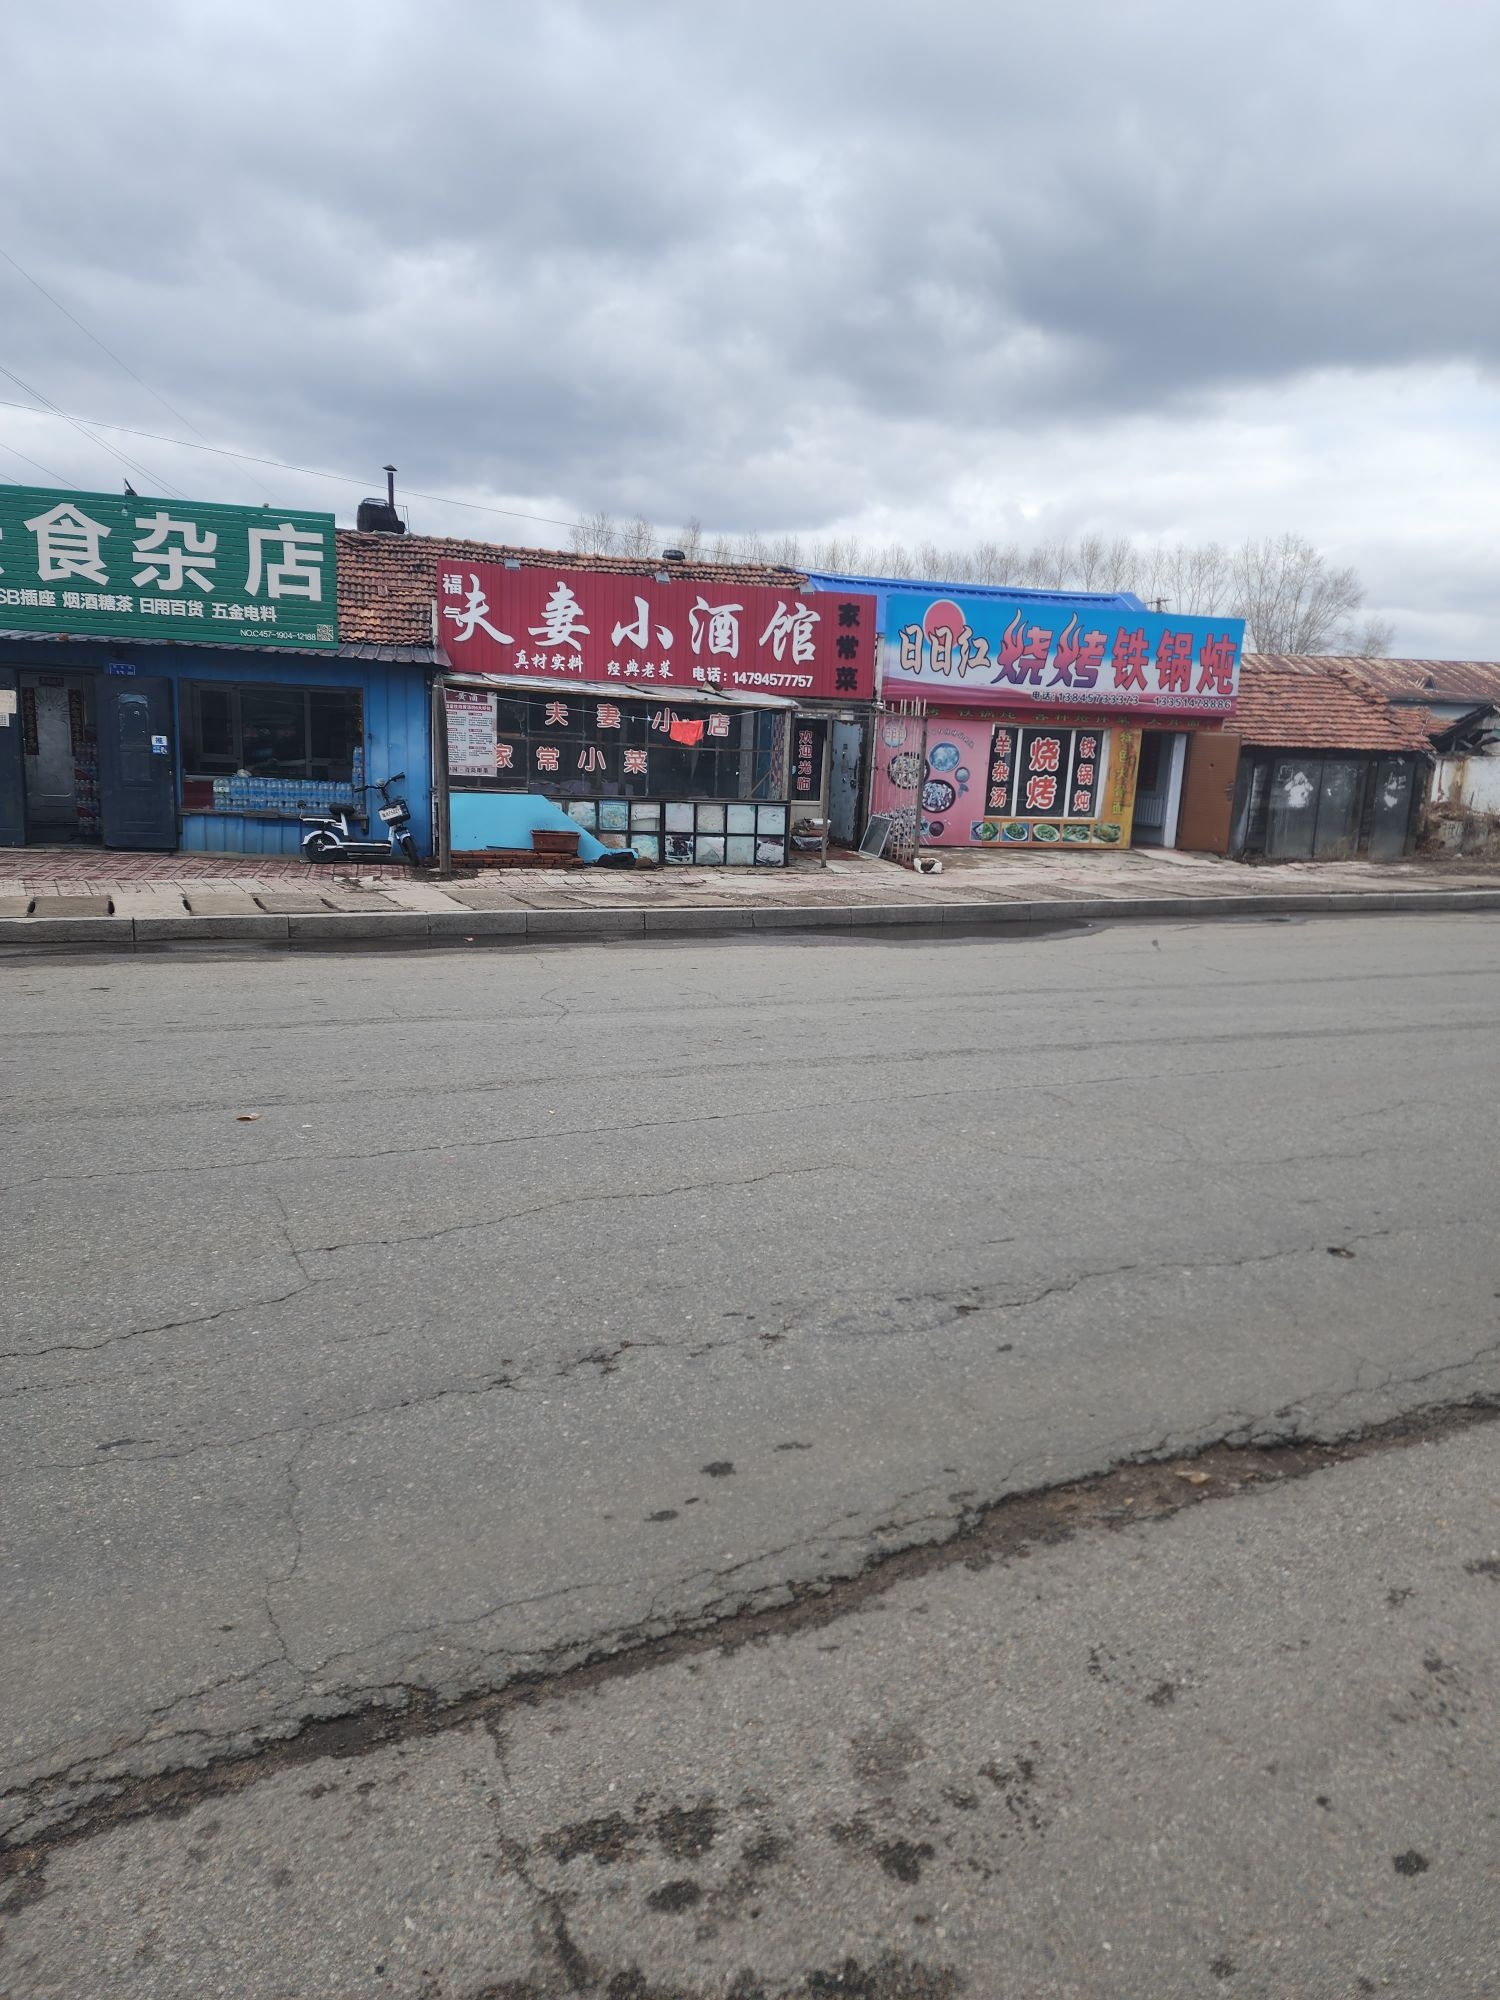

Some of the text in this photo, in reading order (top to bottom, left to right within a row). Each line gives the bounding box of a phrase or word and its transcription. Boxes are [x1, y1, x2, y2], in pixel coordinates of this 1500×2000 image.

[0, 502, 324, 602] 食杂店
[62, 591, 134, 613] 烟酒糖茶
[139, 597, 204, 618] 日用百货
[211, 602, 277, 623] 五金电料
[442, 573, 464, 628] 福气
[453, 573, 821, 667] 夫妻小酒馆
[513, 649, 584, 673] 真材实料
[607, 659, 673, 679] 经典老菜
[835, 602, 861, 692] 家常菜
[544, 701, 731, 738] 夫妻小店
[496, 742, 648, 775] 家常小菜
[796, 730, 813, 791] 欢迎光临
[989, 730, 1011, 808] 羊杂汤
[1026, 737, 1061, 809] 烧烤
[1073, 737, 1096, 811] 铁锅炖
